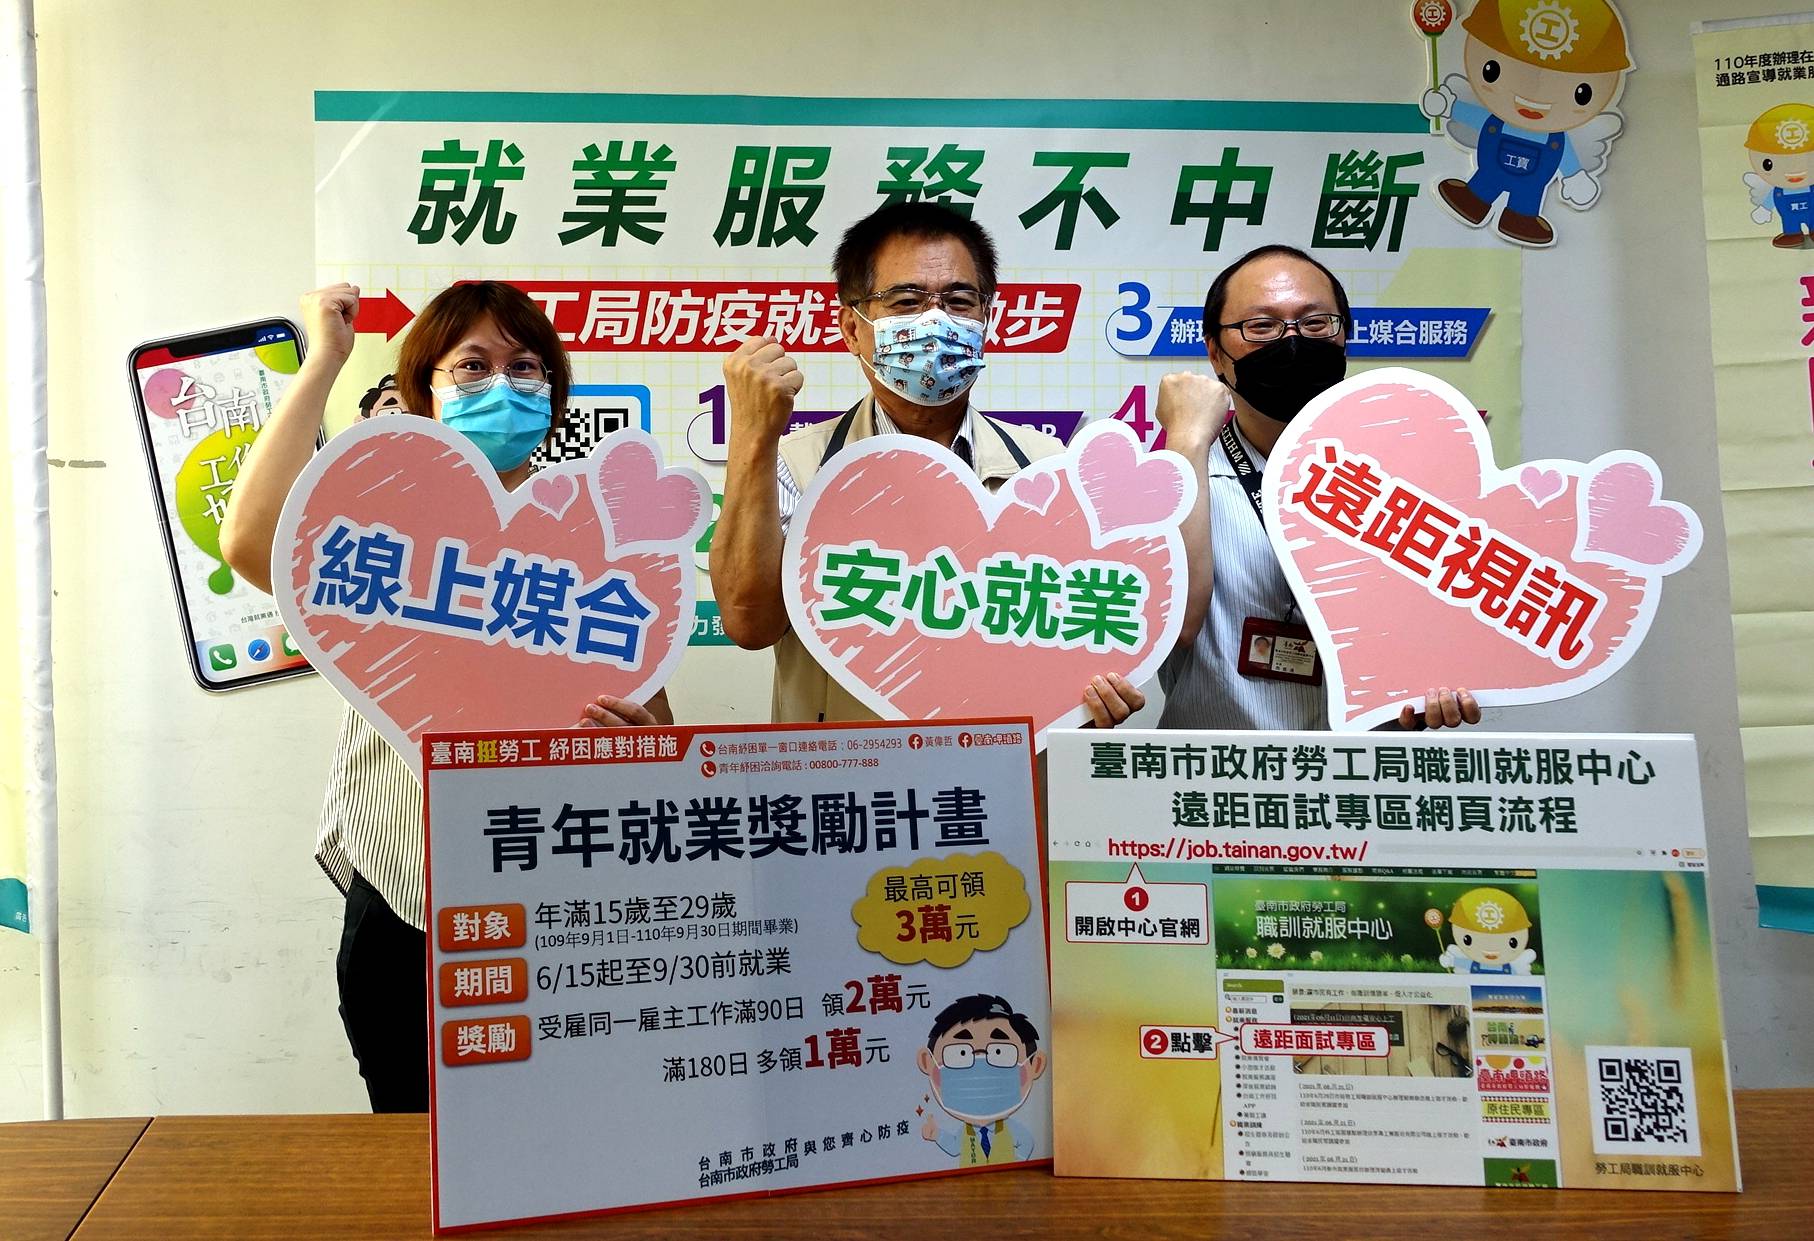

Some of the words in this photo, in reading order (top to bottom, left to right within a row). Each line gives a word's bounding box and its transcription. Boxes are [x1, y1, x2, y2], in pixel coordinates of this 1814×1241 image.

[1116, 281, 1153, 341] 3
[1346, 319, 1468, 345] 上媒合服務
[170, 374, 262, 439] 台南
[698, 384, 725, 444] 1
[1110, 385, 1154, 443] 4
[1292, 446, 1599, 661] 遠距視訊
[312, 525, 652, 663] 線上媒合
[820, 548, 1142, 646] 安心就業
[430, 738, 543, 766] 臺南挺勞工
[549, 734, 679, 761] 紓困應對措施
[1090, 741, 1657, 786] 臺南市政府勞工局職訓就服中心
[483, 785, 990, 873] 青年就業獎勵計畫
[1171, 790, 1579, 834] 遠距面試專區網頁流程
[1108, 837, 1369, 861] https://job.tainan.gov.tw/
[884, 870, 986, 903] 最高可領
[452, 910, 512, 942] 對象
[534, 891, 737, 930] 年滿15歲至29歲
[896, 903, 980, 944] 3萬元
[1255, 915, 1393, 940] 職訓就服中心
[454, 965, 513, 998] 期間
[536, 947, 792, 994] 6/15起至9/30前就業
[821, 973, 931, 1018] 領2萬元
[457, 1022, 516, 1056] 獎勵
[1171, 1031, 1214, 1054] 點擊
[1253, 1028, 1377, 1052] 遠距面試專區
[662, 1051, 748, 1082] 滿180日
[1486, 1103, 1544, 1116] 原住民專區
[698, 1153, 800, 1189] 台南市政府勞工局
[1594, 1162, 1705, 1177] 勞工局職訓就服中心
